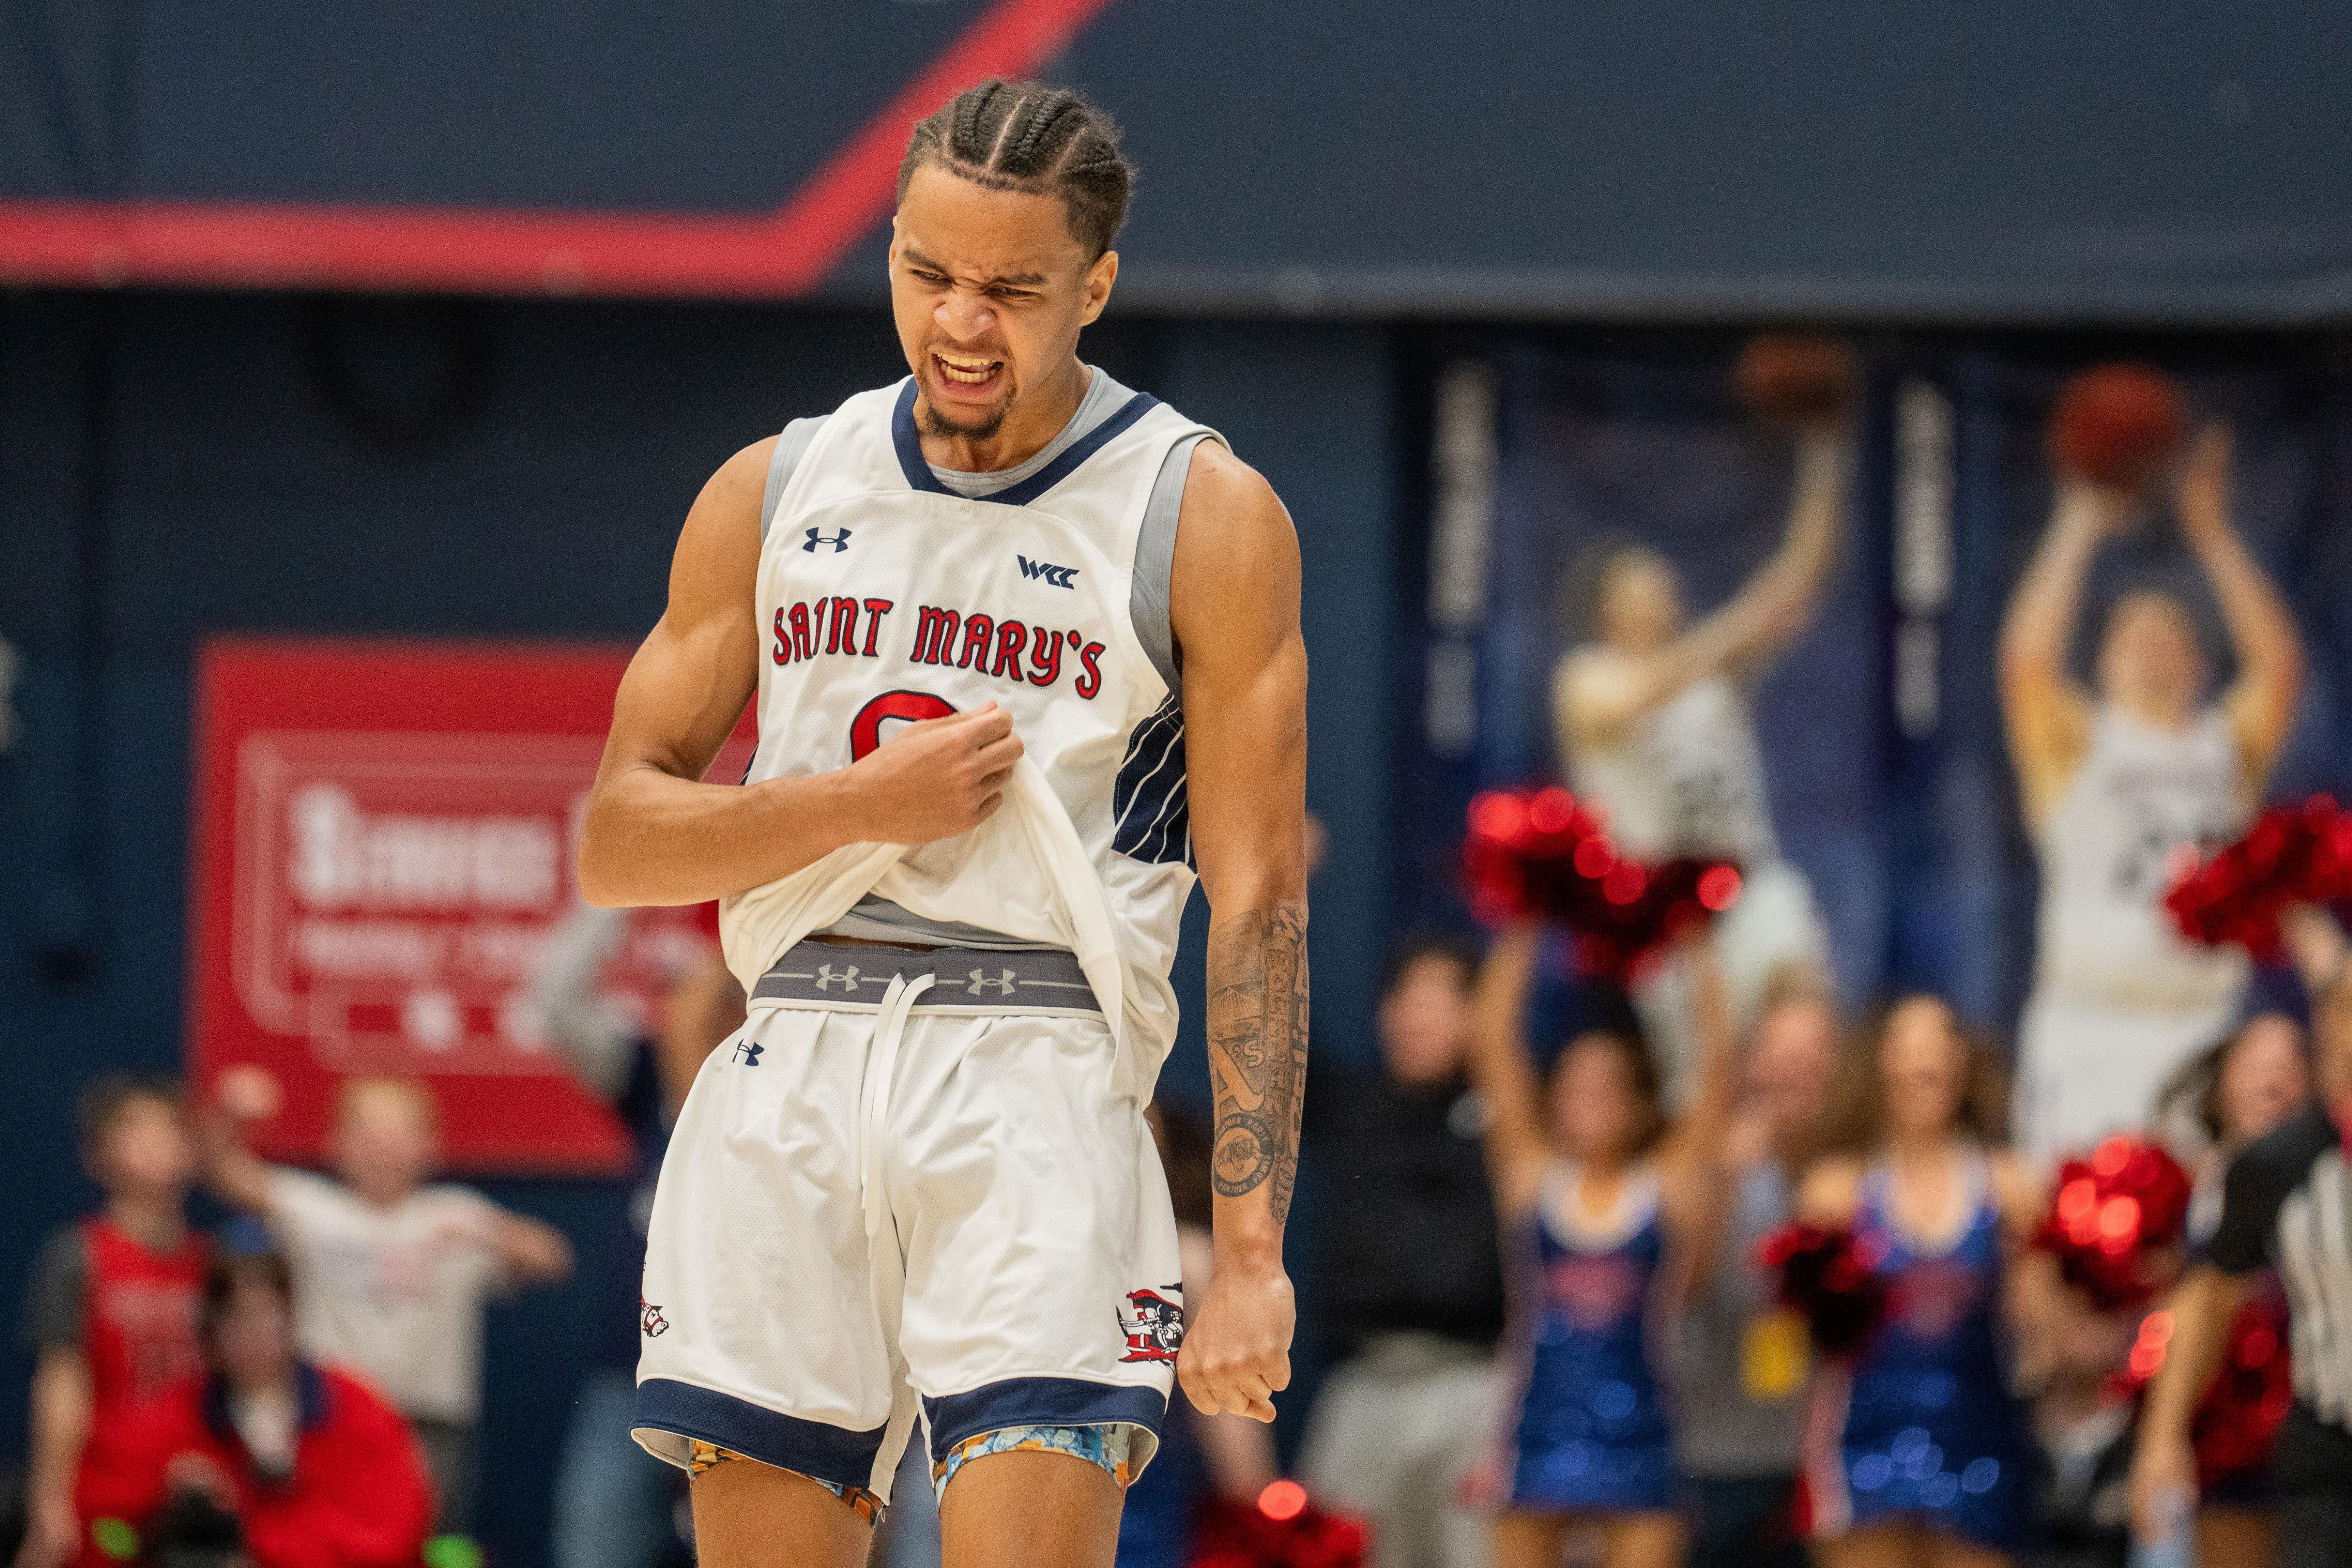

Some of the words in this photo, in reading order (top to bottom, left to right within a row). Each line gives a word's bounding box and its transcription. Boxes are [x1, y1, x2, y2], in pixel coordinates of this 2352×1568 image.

[1016, 554, 1080, 590] WCC
[772, 596, 894, 666] SAINT
[909, 604, 1107, 701] MARY'S
